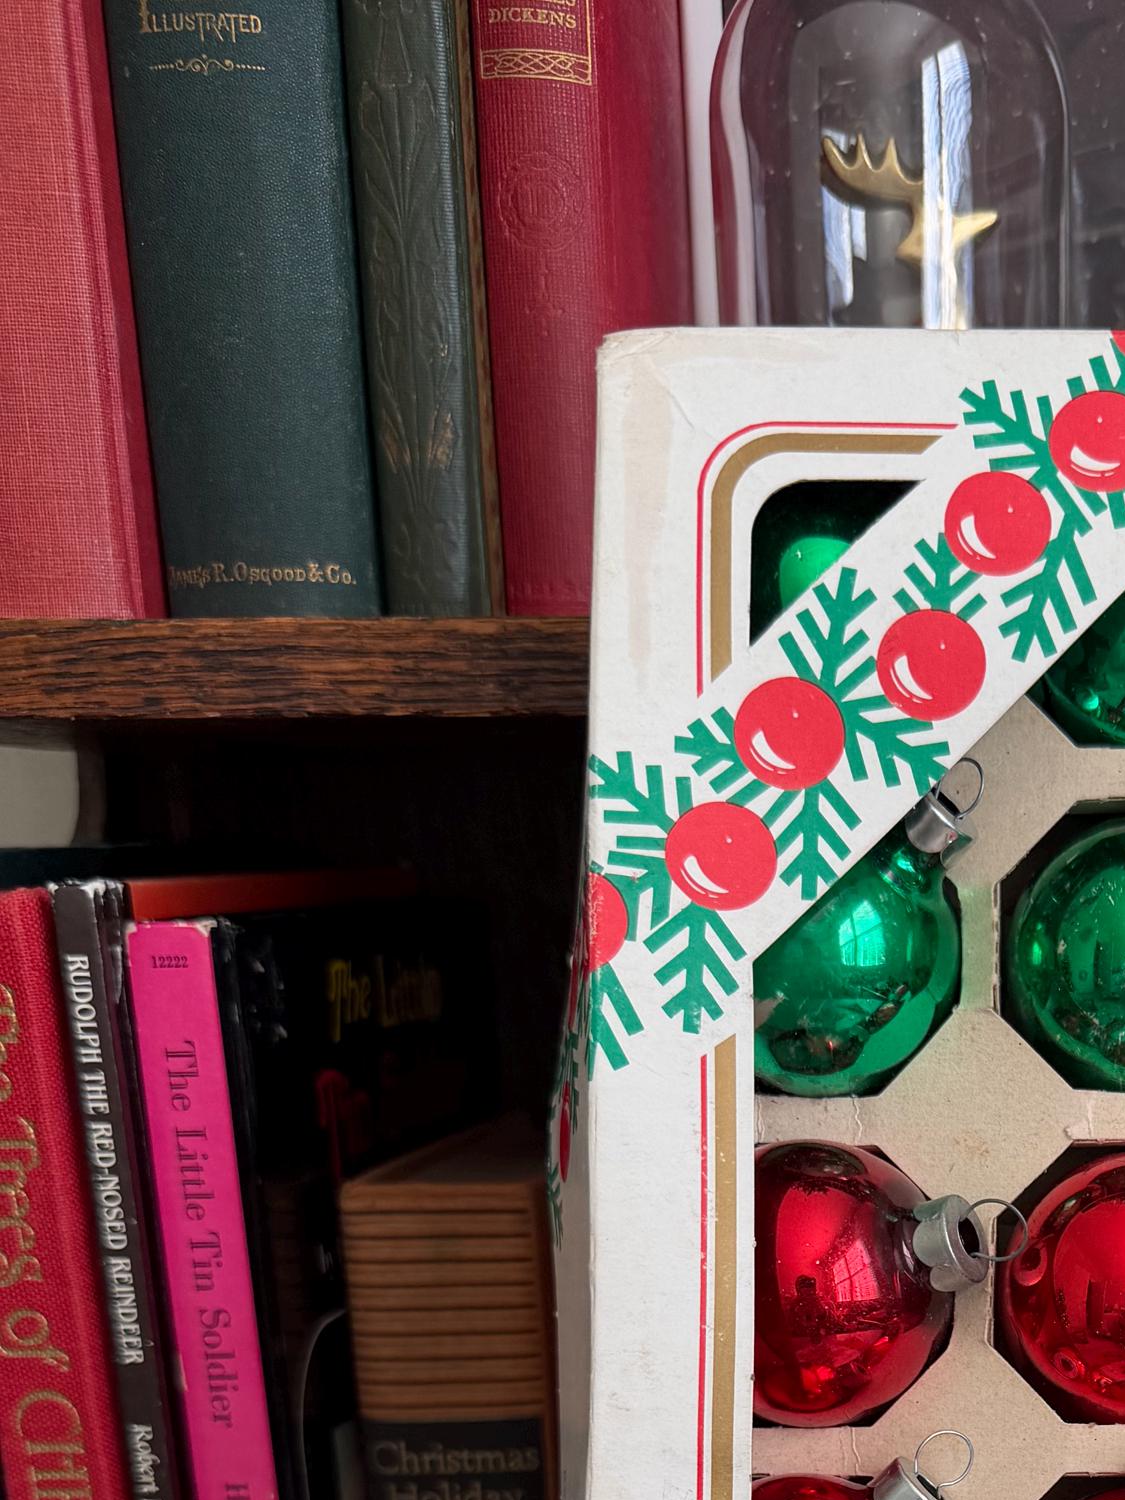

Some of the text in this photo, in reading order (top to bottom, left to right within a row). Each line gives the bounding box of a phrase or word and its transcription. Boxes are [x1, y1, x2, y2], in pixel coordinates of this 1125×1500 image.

[139, 0, 263, 43] ILLUSTRATED
[487, 7, 577, 29] DICKENS
[306, 561, 324, 583] &
[151, 955, 189, 969] 12222
[66, 953, 145, 1365] RUDOLPH THE RED-NOSED REINDEER
[165, 1039, 240, 1428] The Little Tin Soldier
[0, 1307, 71, 1373] of
[130, 1423, 160, 1495] Robert
[369, 1440, 540, 1477] Christmas
